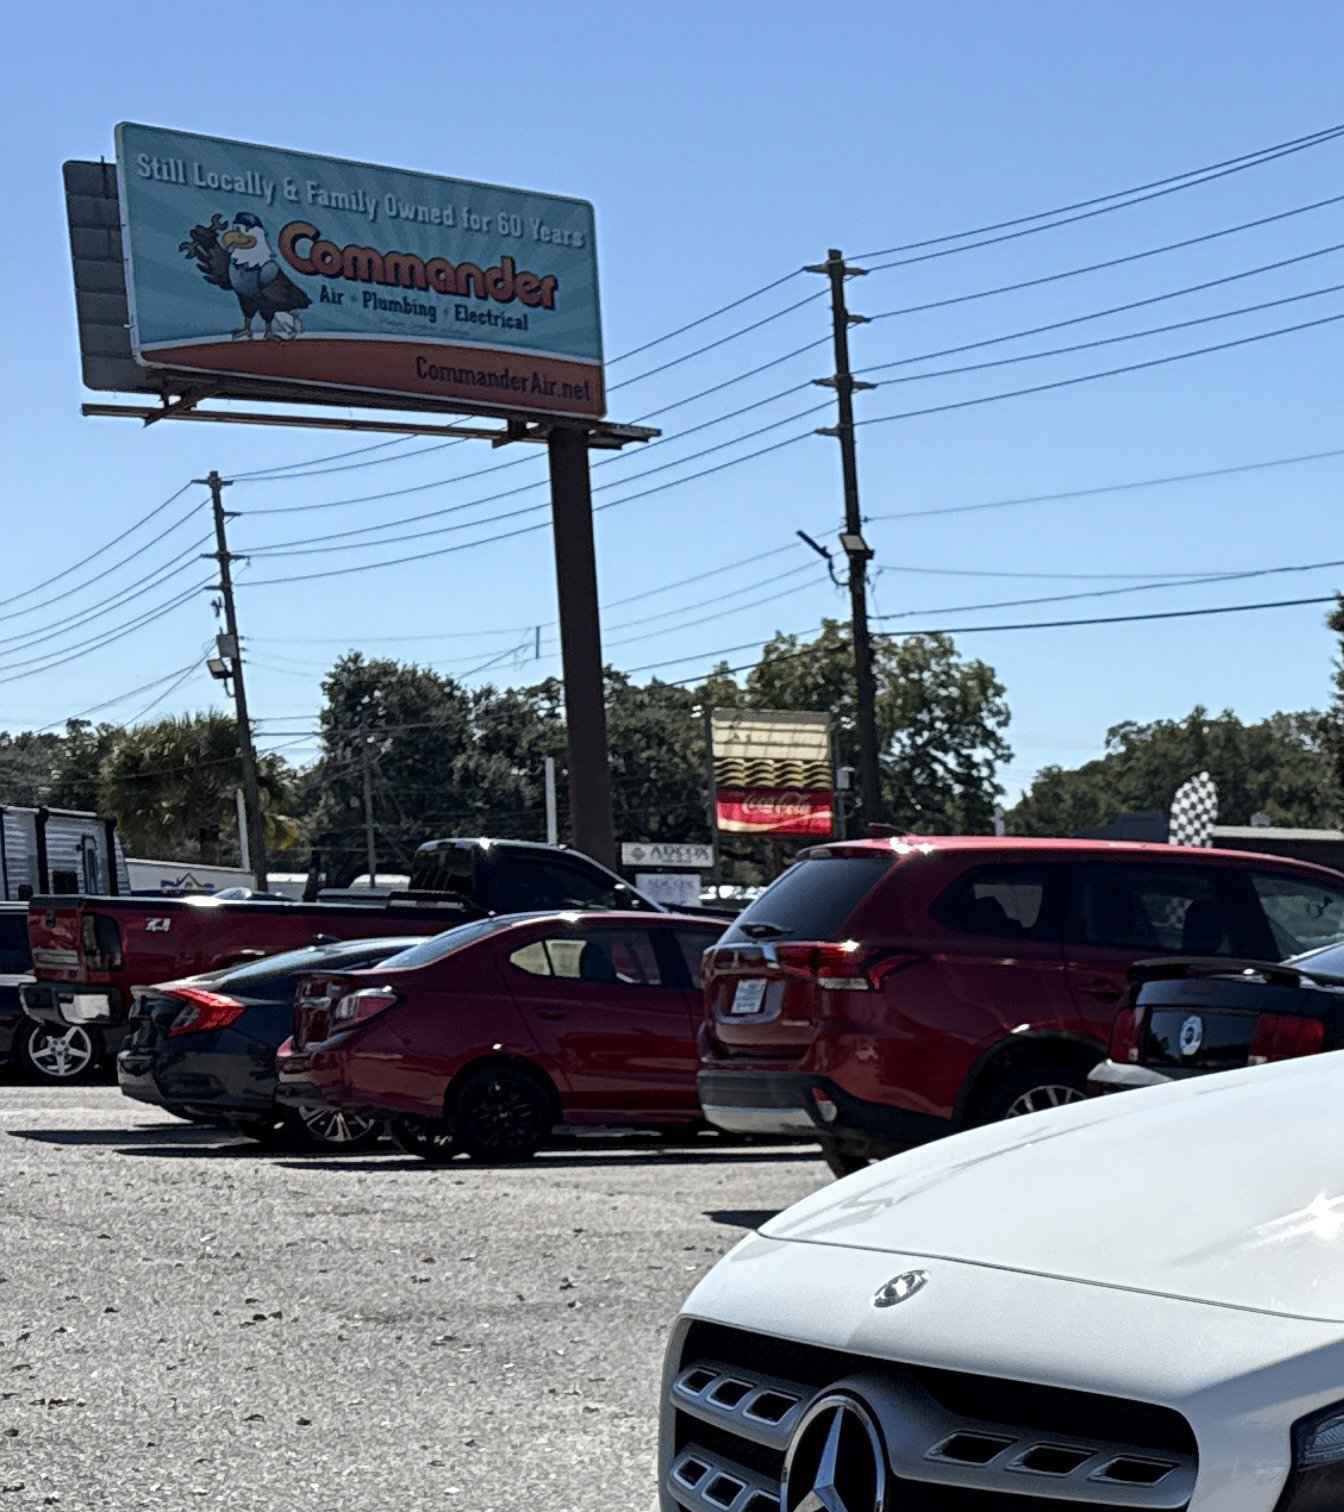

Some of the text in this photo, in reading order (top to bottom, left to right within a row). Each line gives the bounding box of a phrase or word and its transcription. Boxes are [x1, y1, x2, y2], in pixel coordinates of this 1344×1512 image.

[137, 153, 585, 248] Still Locally & Family Owned for 60 Years
[278, 220, 558, 310] Commander
[319, 285, 344, 305] Air
[362, 291, 437, 323] Plumbing
[454, 304, 529, 331] Electrical
[416, 356, 591, 401] CommanderAir.net
